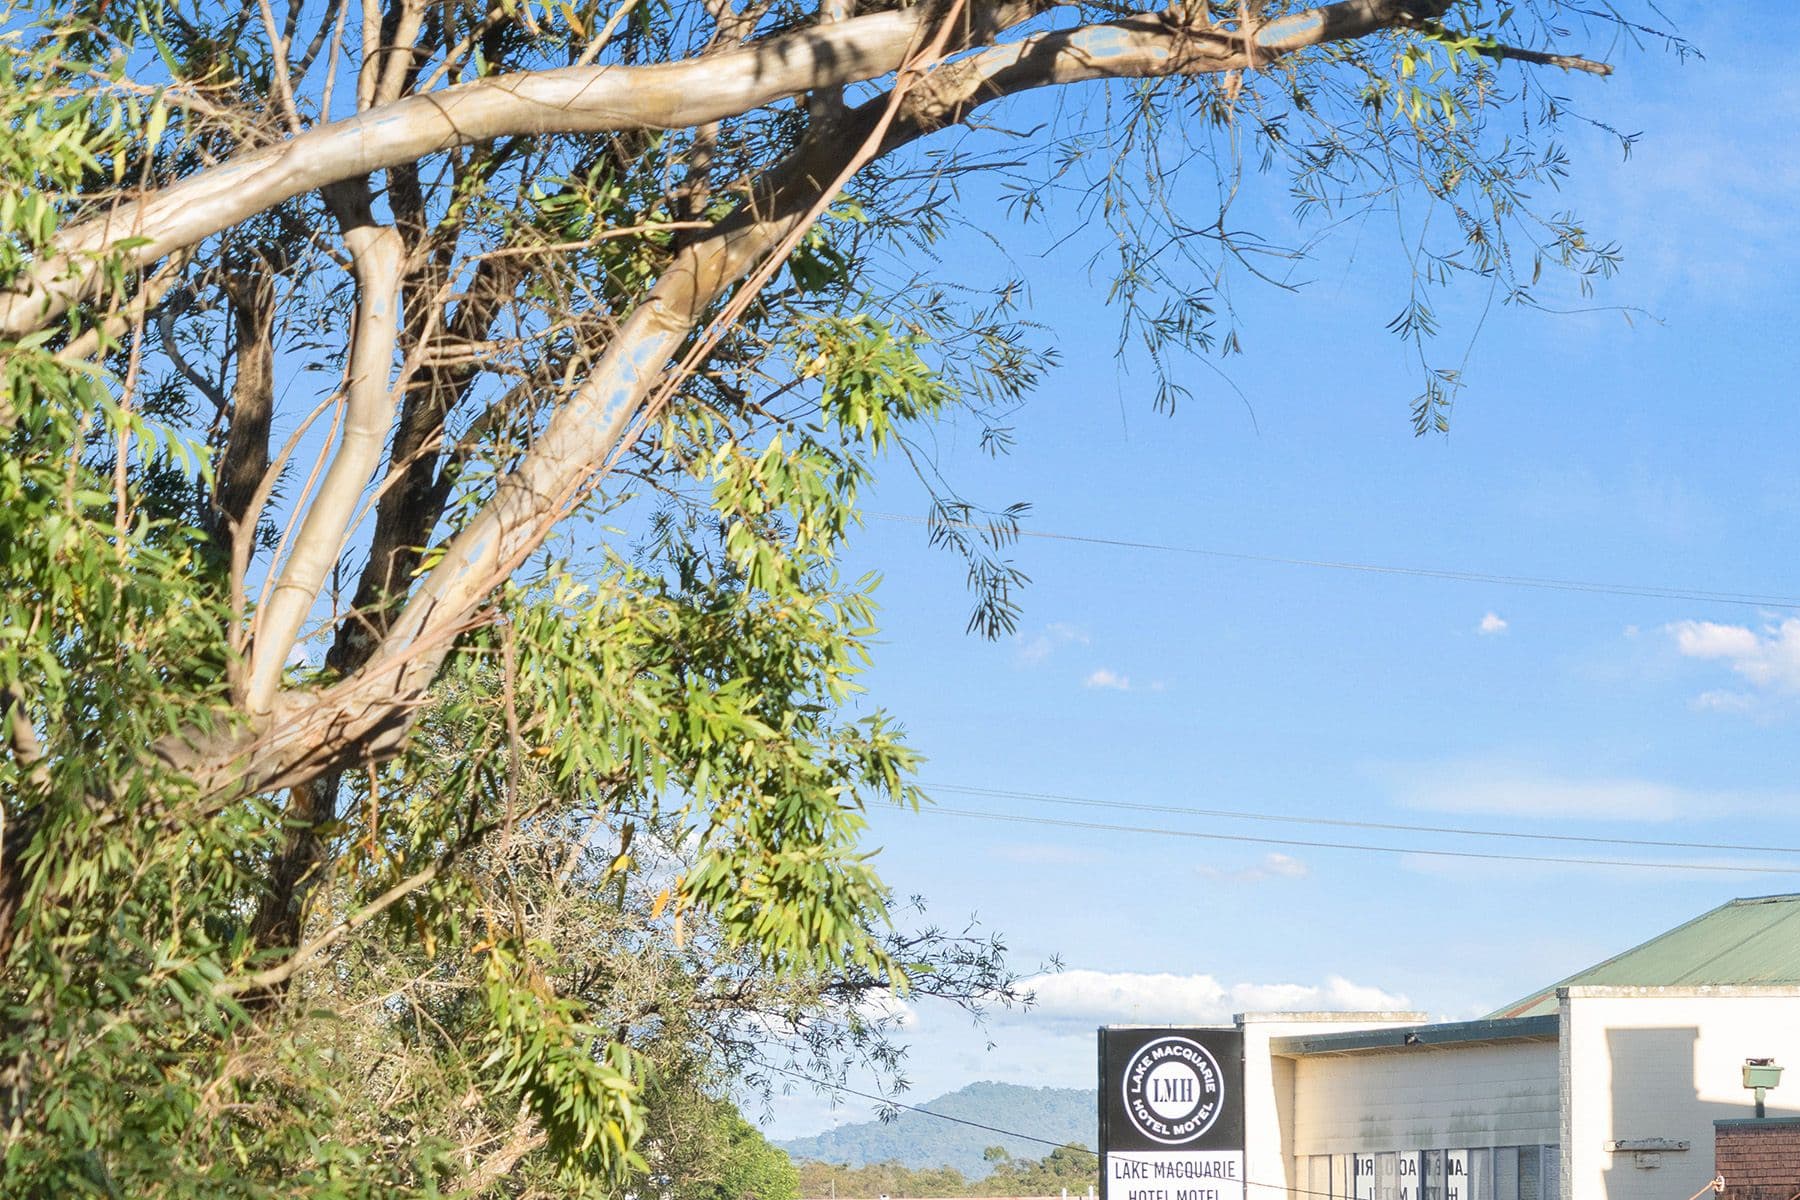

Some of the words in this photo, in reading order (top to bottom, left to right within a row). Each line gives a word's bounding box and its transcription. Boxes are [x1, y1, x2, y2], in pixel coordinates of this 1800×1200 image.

[1131, 1055, 1153, 1093] LAKE
[1151, 1045, 1216, 1093] MACQUARIE
[1153, 1078, 1193, 1102] LMH
[1133, 1099, 1170, 1135] HOTEL
[1173, 1102, 1214, 1135] MOTEL
[1115, 1162, 1149, 1179] LAKE
[1154, 1161, 1236, 1179] MACQUARIE
